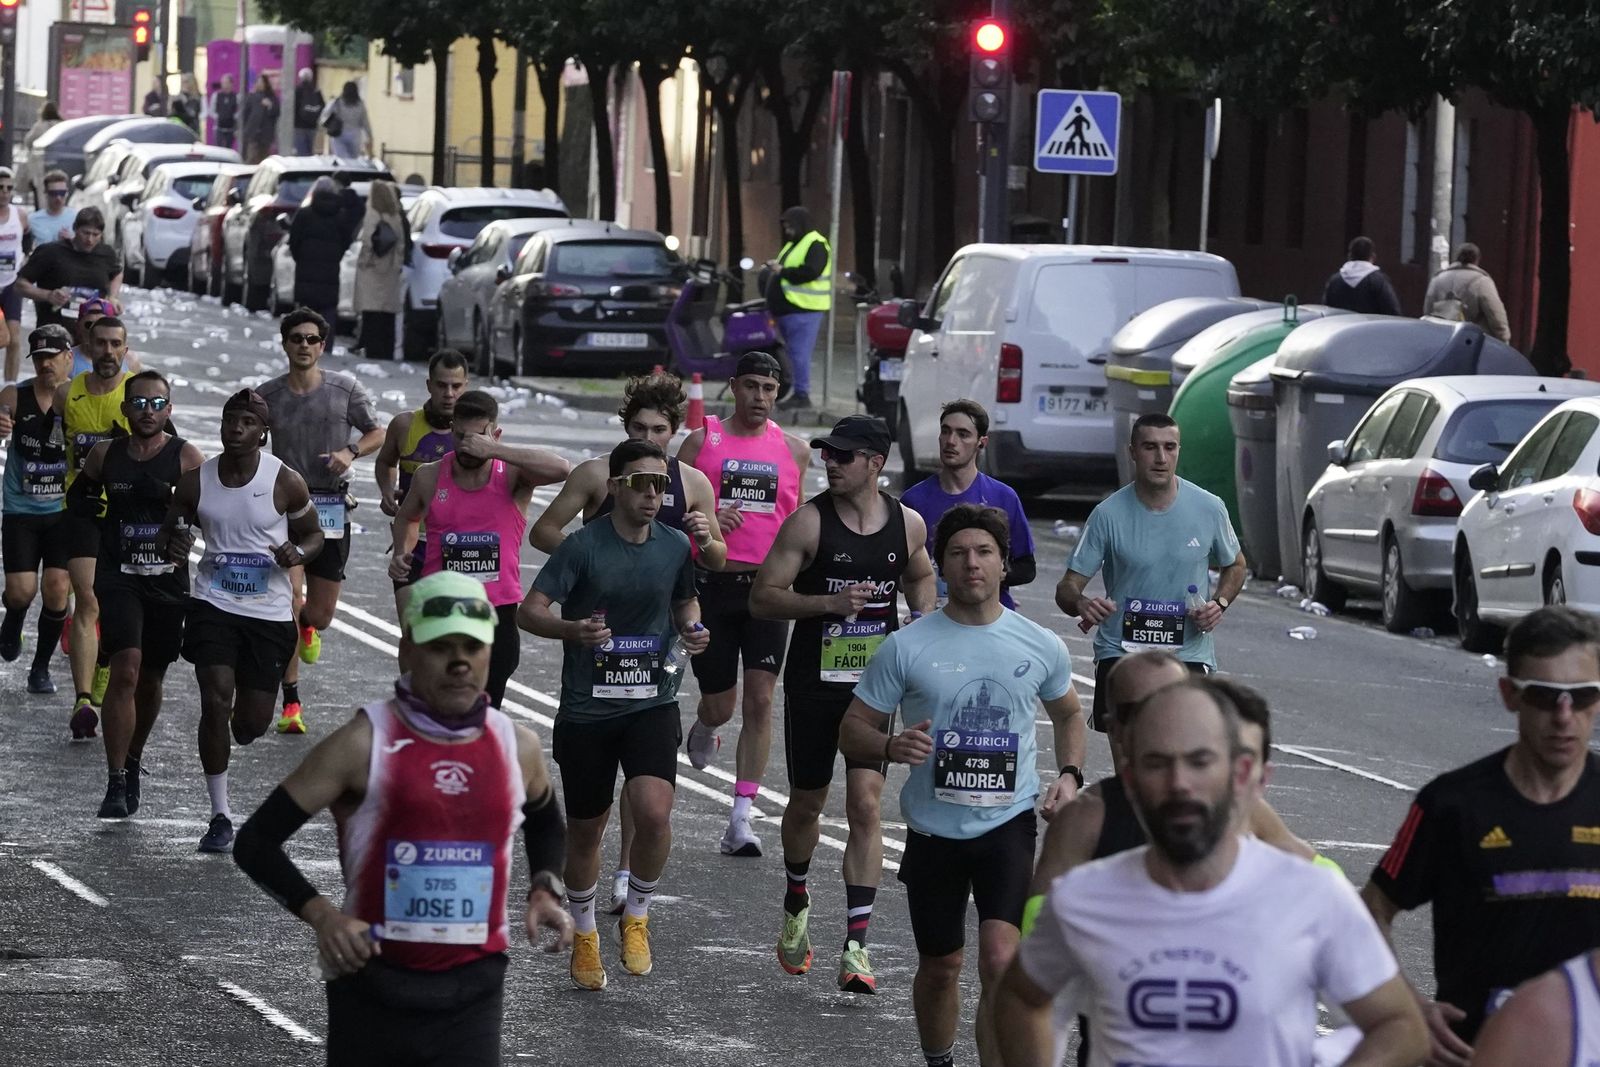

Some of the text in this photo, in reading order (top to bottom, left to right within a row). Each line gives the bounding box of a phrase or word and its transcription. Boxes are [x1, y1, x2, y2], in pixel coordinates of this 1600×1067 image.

[1047, 396, 1081, 412] 9177
[742, 464, 773, 472] ZURICH
[741, 478, 759, 486] 5097
[32, 483, 63, 494] FRANK
[731, 488, 766, 500] MARIO
[461, 535, 493, 543] ZURICH
[139, 543, 156, 551] 4101
[462, 550, 480, 559] 5098
[230, 556, 264, 567] ZURICH
[446, 561, 496, 572] CRISTIAN
[1145, 604, 1179, 613] ZURICH
[1144, 618, 1164, 628] 4682
[846, 624, 880, 635] ZURICH
[1133, 630, 1174, 643] ESTEVE
[618, 640, 654, 650] ZURICH
[847, 643, 866, 654] 1904
[619, 658, 639, 668] 4543
[605, 668, 651, 684] RAMÓN
[965, 736, 1009, 748] ZURICH
[965, 758, 989, 769] 4736
[944, 772, 1006, 790] ANDREA
[422, 847, 482, 862] ZURICH
[404, 898, 473, 918] JOSE D
